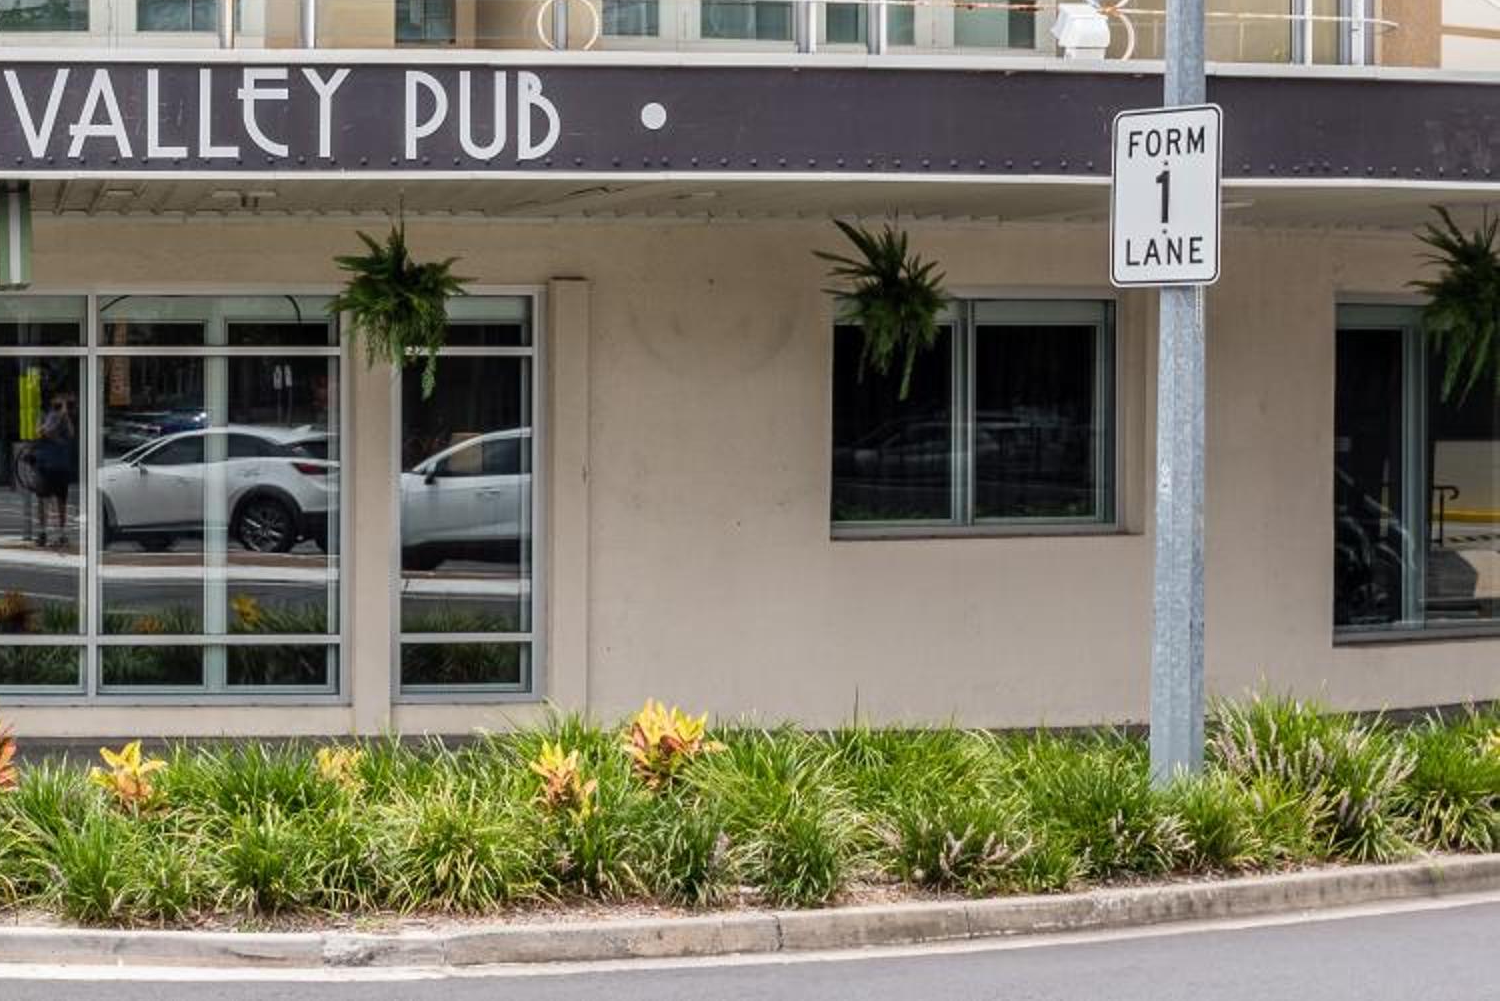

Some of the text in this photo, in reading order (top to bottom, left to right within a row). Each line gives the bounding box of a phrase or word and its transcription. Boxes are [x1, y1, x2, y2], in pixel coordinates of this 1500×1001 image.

[3, 67, 351, 159] VALLEY
[404, 69, 562, 161] PUB
[1128, 126, 1205, 159] FORM
[1156, 170, 1171, 224] 1
[1126, 236, 1204, 266] LANE
